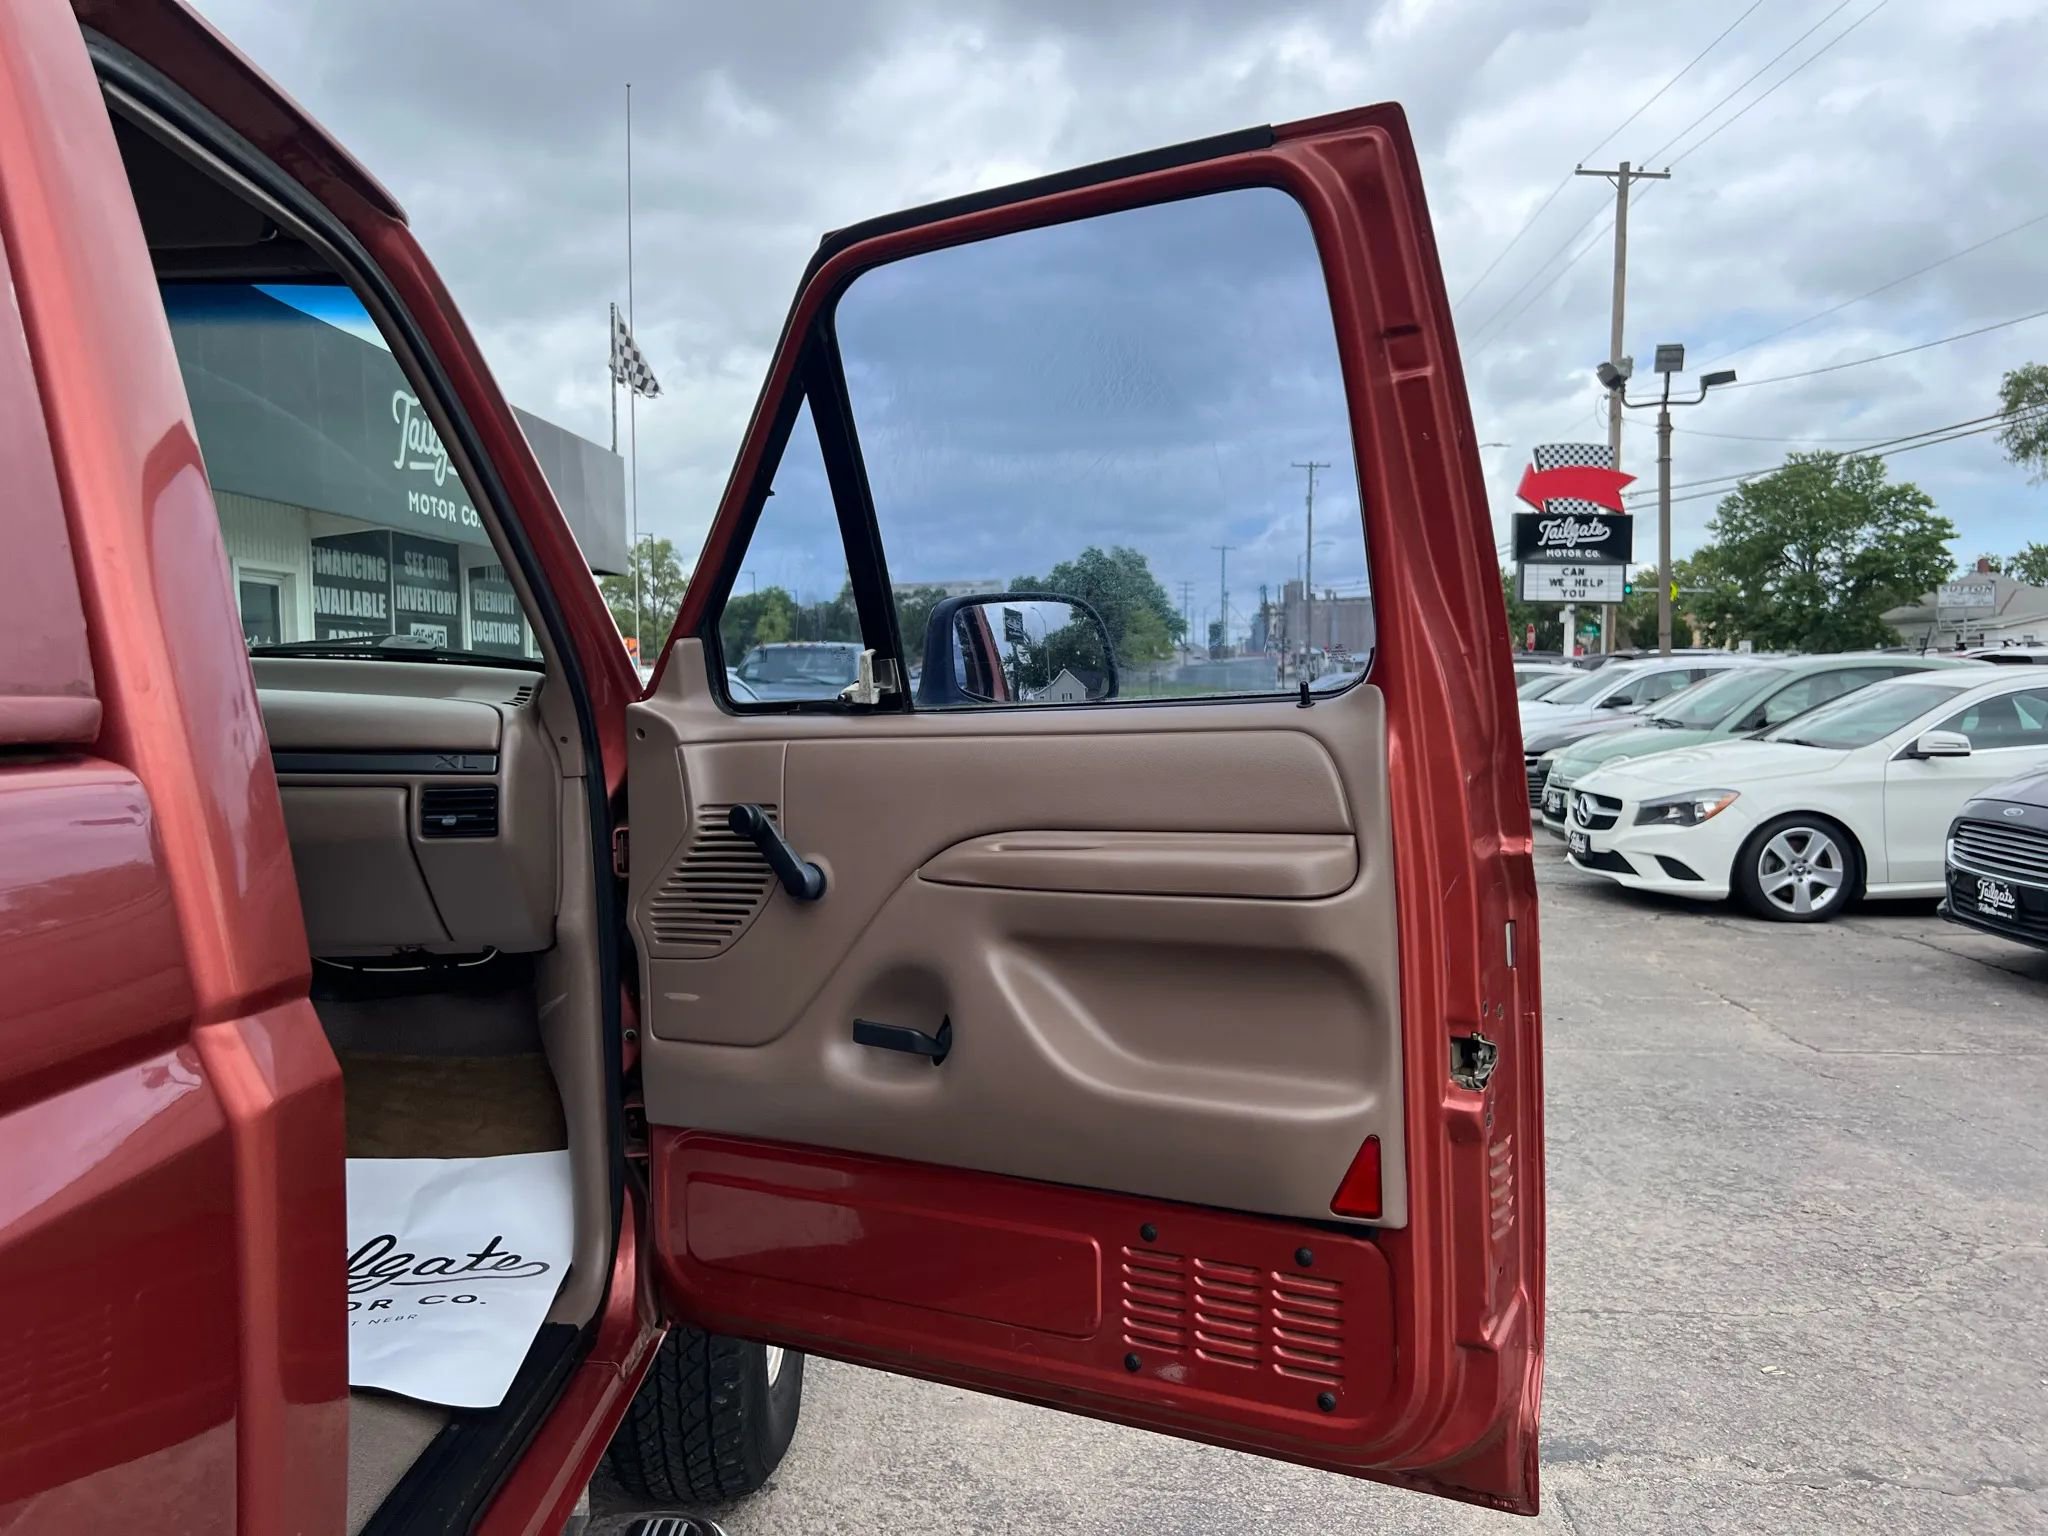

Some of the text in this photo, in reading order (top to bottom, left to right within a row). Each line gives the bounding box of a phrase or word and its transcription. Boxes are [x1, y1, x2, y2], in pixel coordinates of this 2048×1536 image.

[408, 490, 457, 523] MOTOR
[1537, 516, 1611, 547] Tailgate
[1546, 548, 1601, 558] MOTOR CO.
[405, 551, 449, 582] SEE OUR
[1562, 567, 1585, 576] CAN
[1549, 578, 1604, 587] WE HELP
[1561, 589, 1586, 598] YOU
[313, 585, 387, 619] AVAILABLE
[396, 584, 458, 615] INVENTORY
[474, 588, 515, 615] FREMONT
[471, 619, 520, 645] LOCATIONS
[434, 755, 478, 769] XL
[1977, 879, 2016, 909] Tailgate
[418, 1294, 487, 1305] CO.
